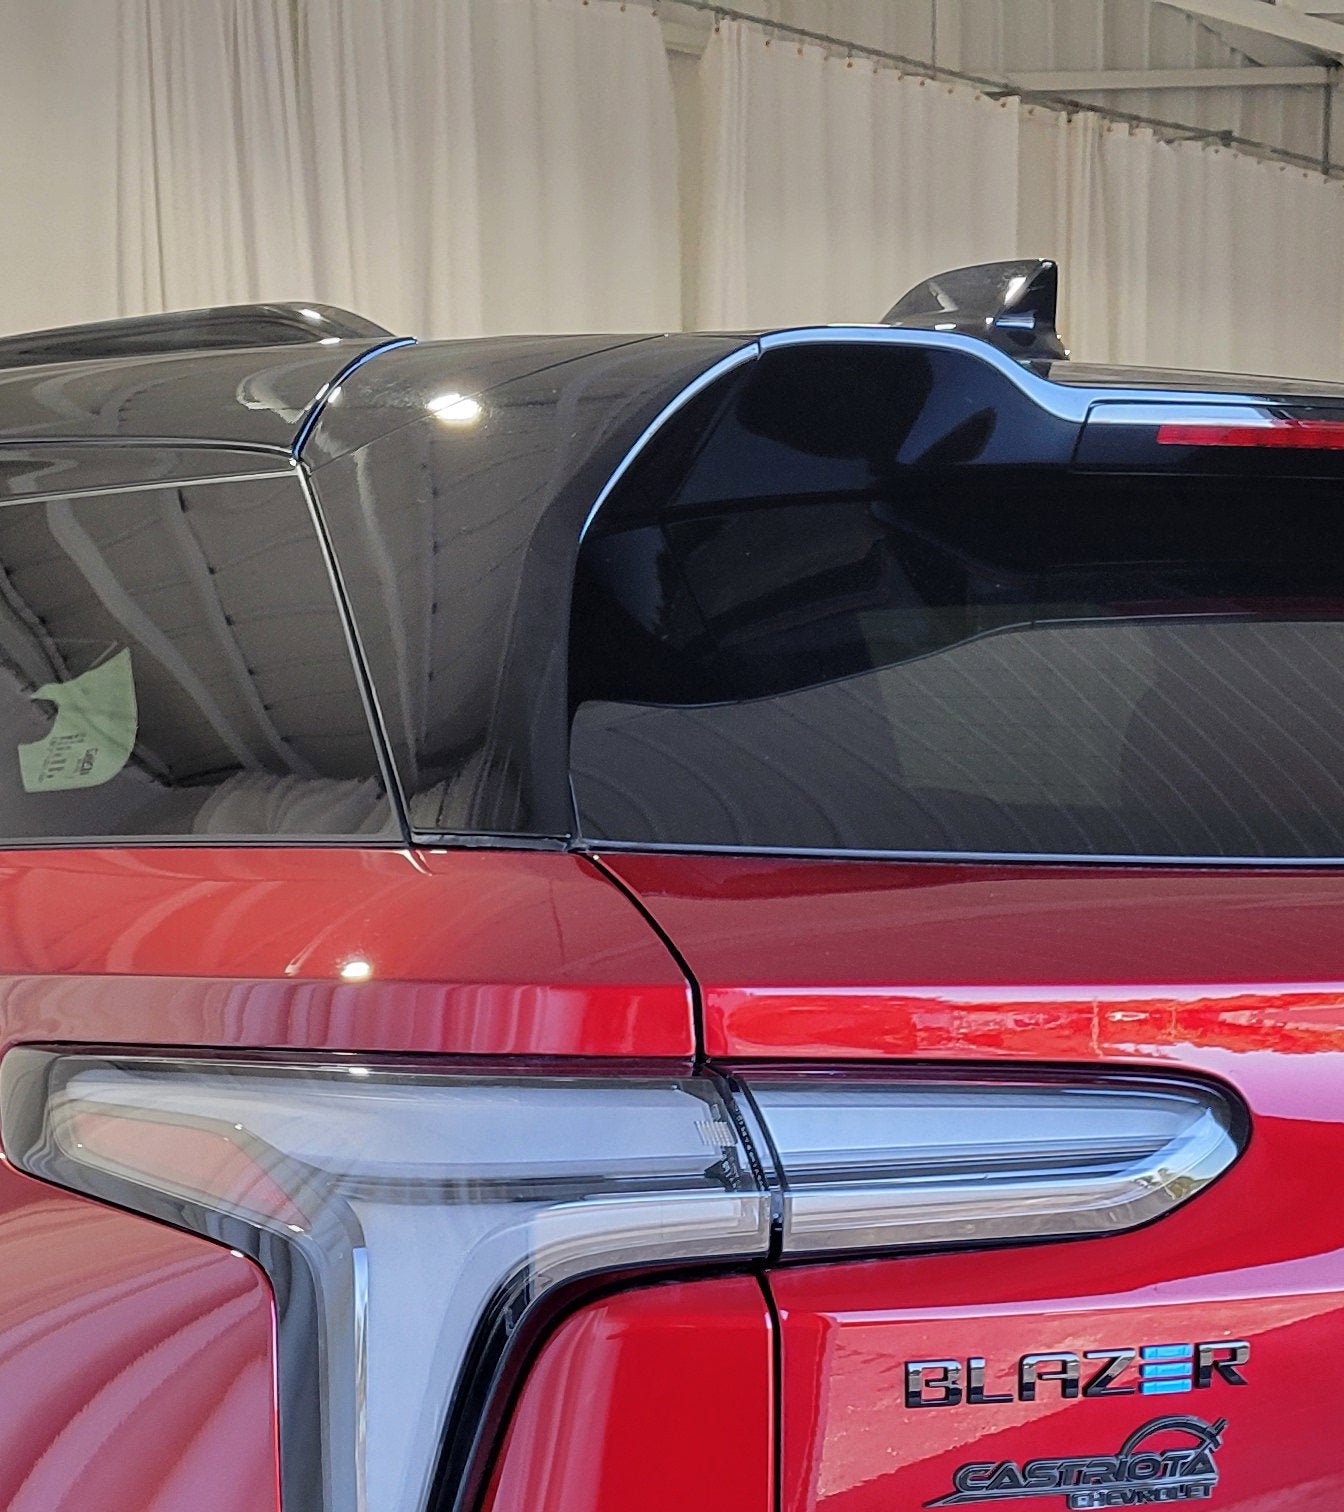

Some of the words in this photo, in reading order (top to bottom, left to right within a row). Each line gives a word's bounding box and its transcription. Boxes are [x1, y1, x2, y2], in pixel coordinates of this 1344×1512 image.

[904, 1339, 1251, 1409] BLAZER
[952, 1448, 1218, 1493] CASTRIOTA
[1066, 1483, 1216, 1511] CHEVROLET
